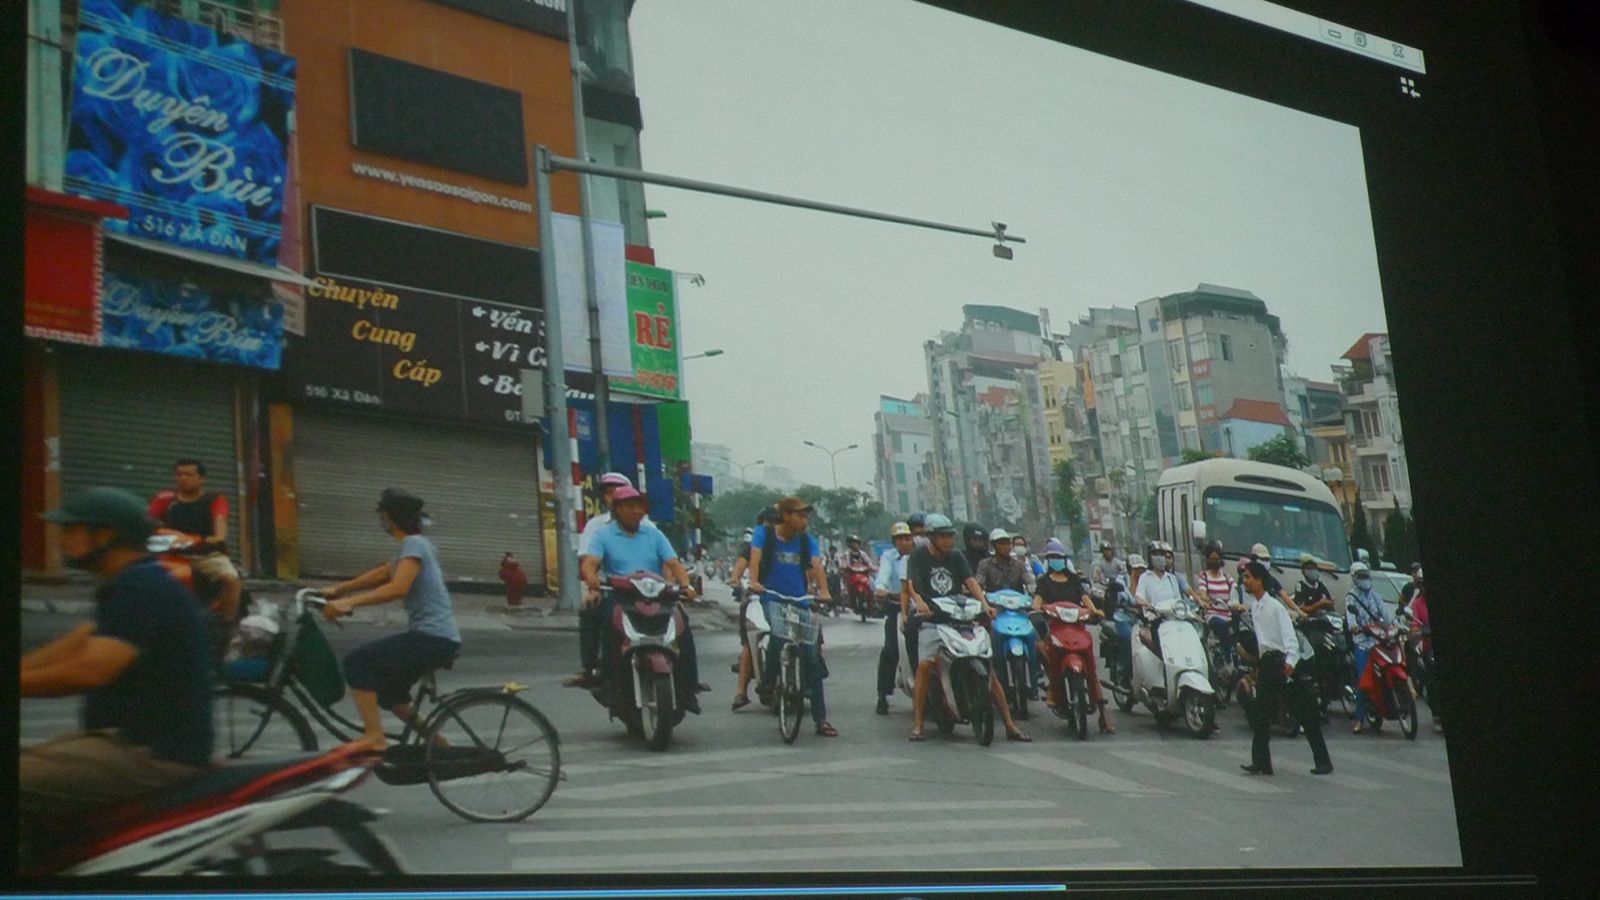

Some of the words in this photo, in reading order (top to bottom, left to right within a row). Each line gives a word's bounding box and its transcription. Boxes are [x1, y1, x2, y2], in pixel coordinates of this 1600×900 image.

[82, 48, 229, 133] Duyên
[351, 162, 532, 213] www.yensaosaigon.com
[143, 214, 176, 237] 516
[308, 275, 400, 311] Chuyên
[352, 319, 416, 352] Cung
[393, 358, 442, 388] Cấp
